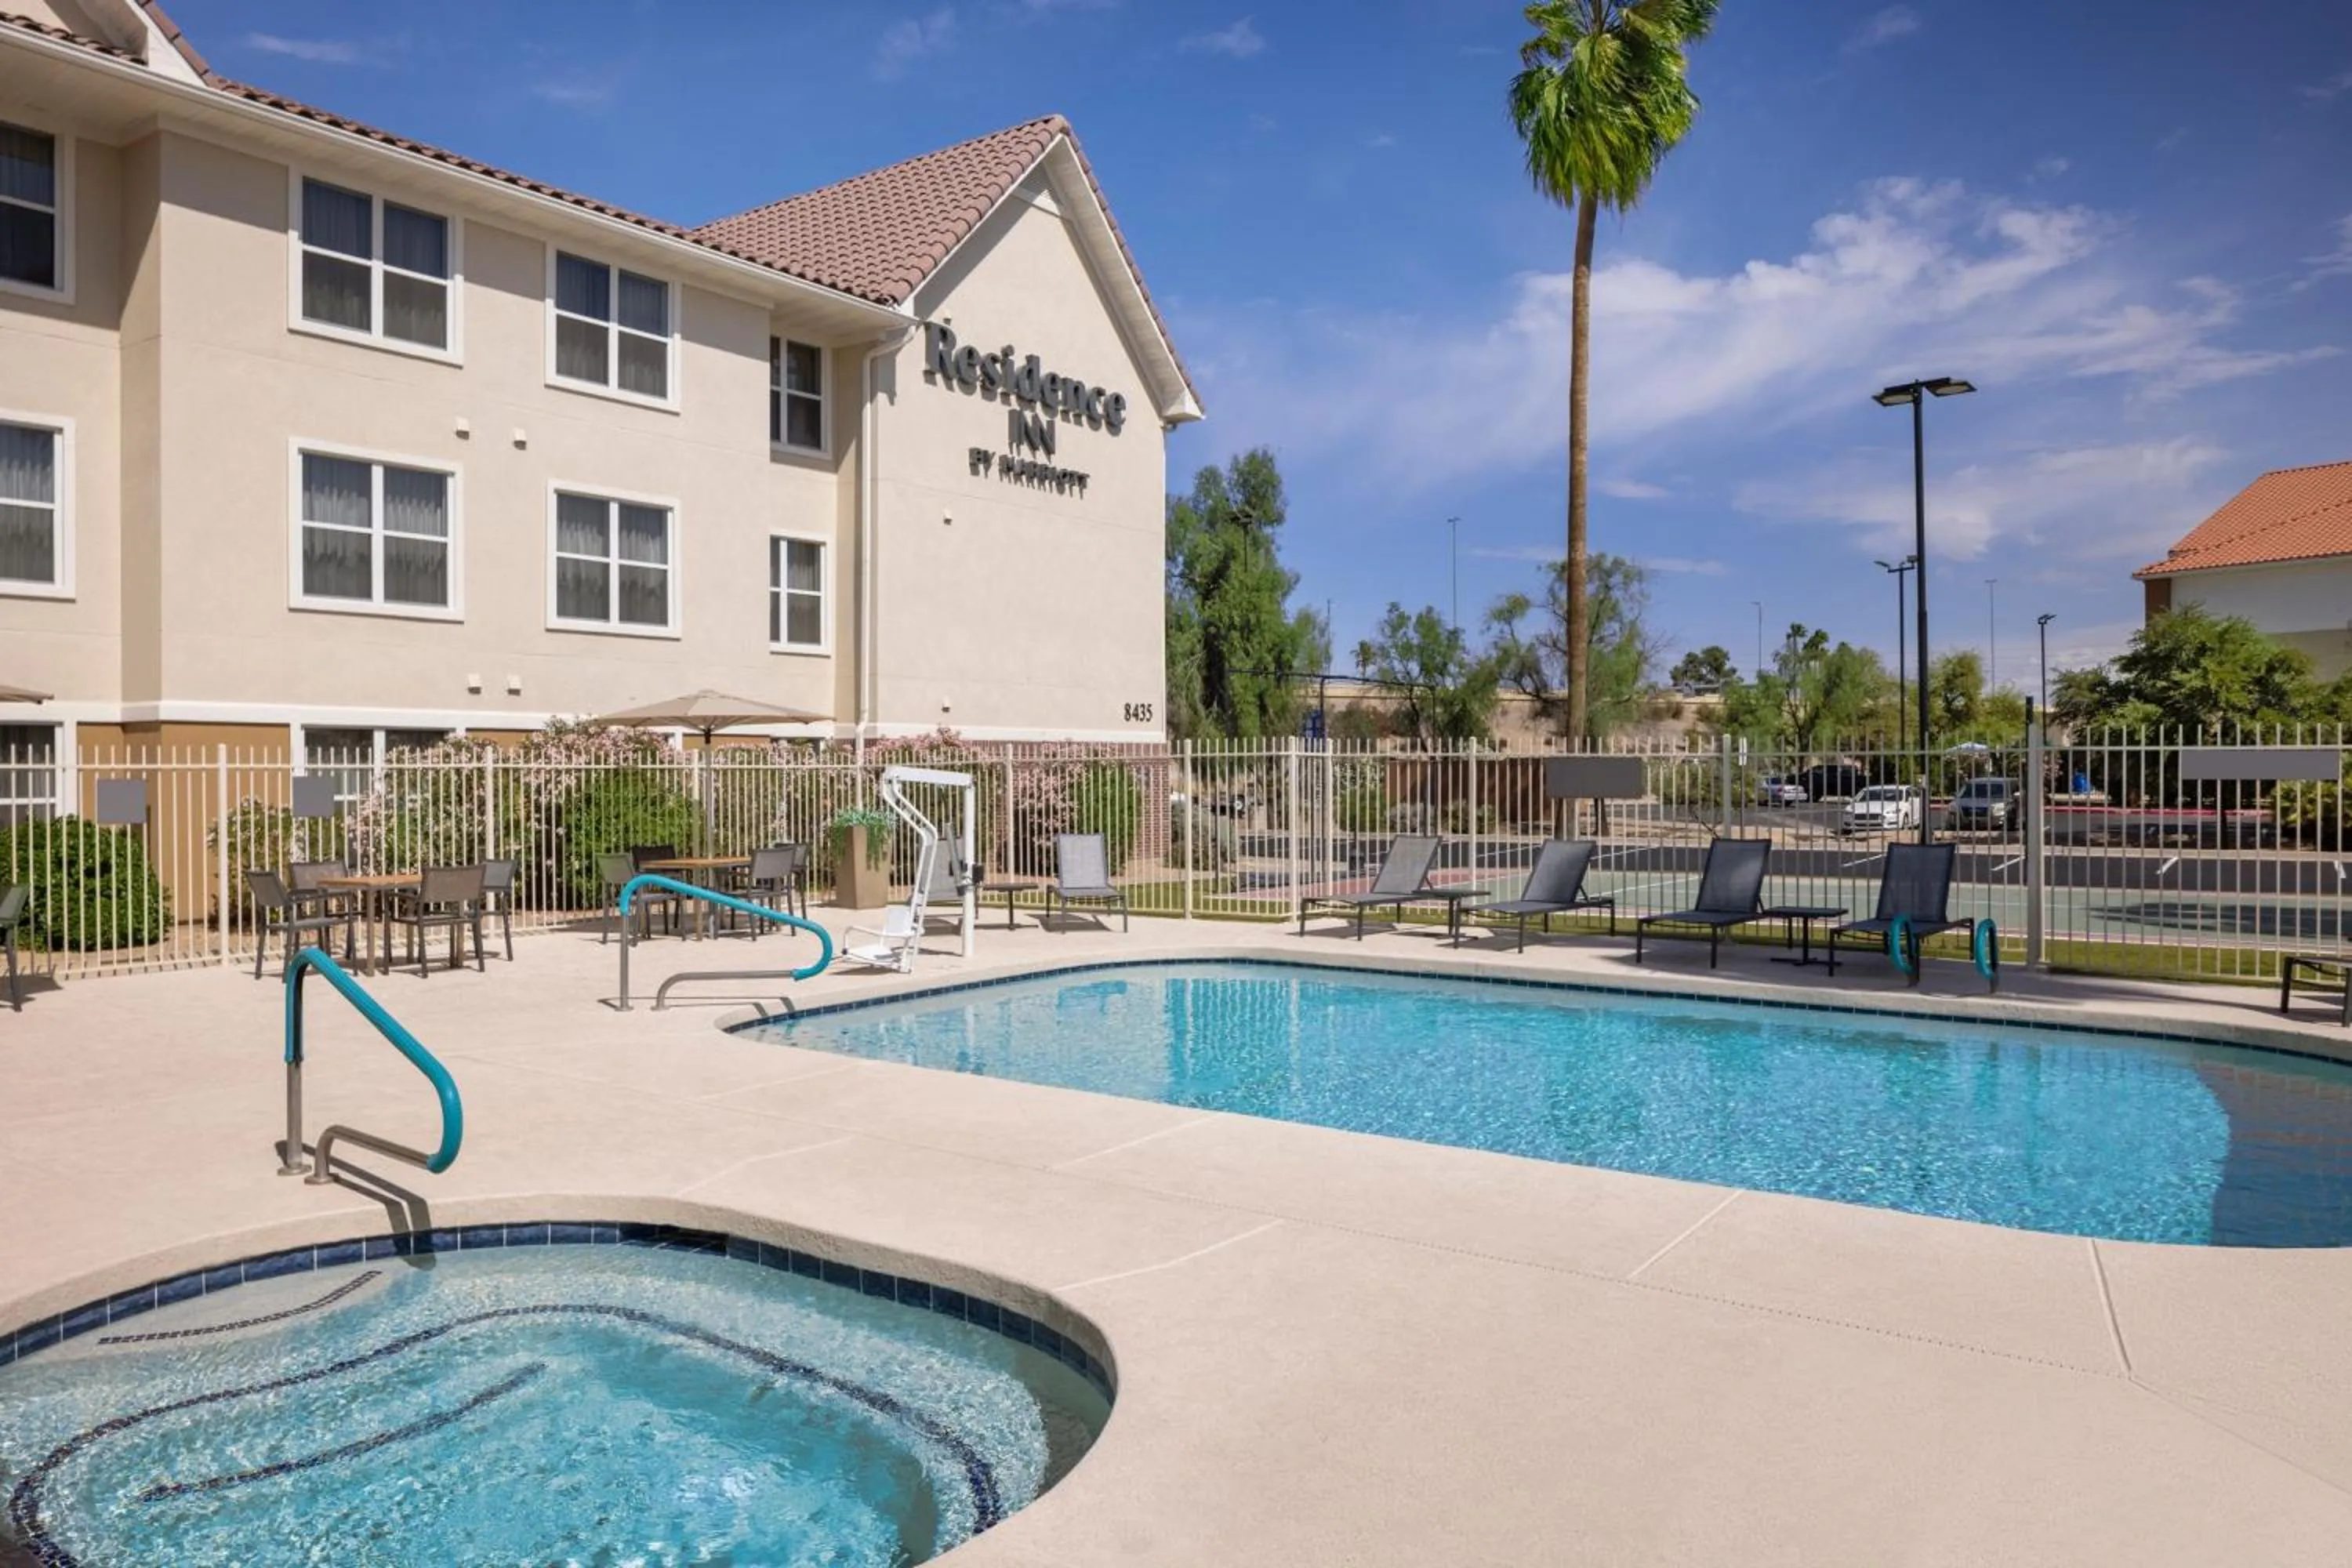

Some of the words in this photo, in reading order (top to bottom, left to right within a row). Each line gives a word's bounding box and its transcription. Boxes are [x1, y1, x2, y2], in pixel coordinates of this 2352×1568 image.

[923, 321, 1127, 429] Residence
[1008, 408, 1056, 456] INN
[1124, 702, 1152, 722] 8435
